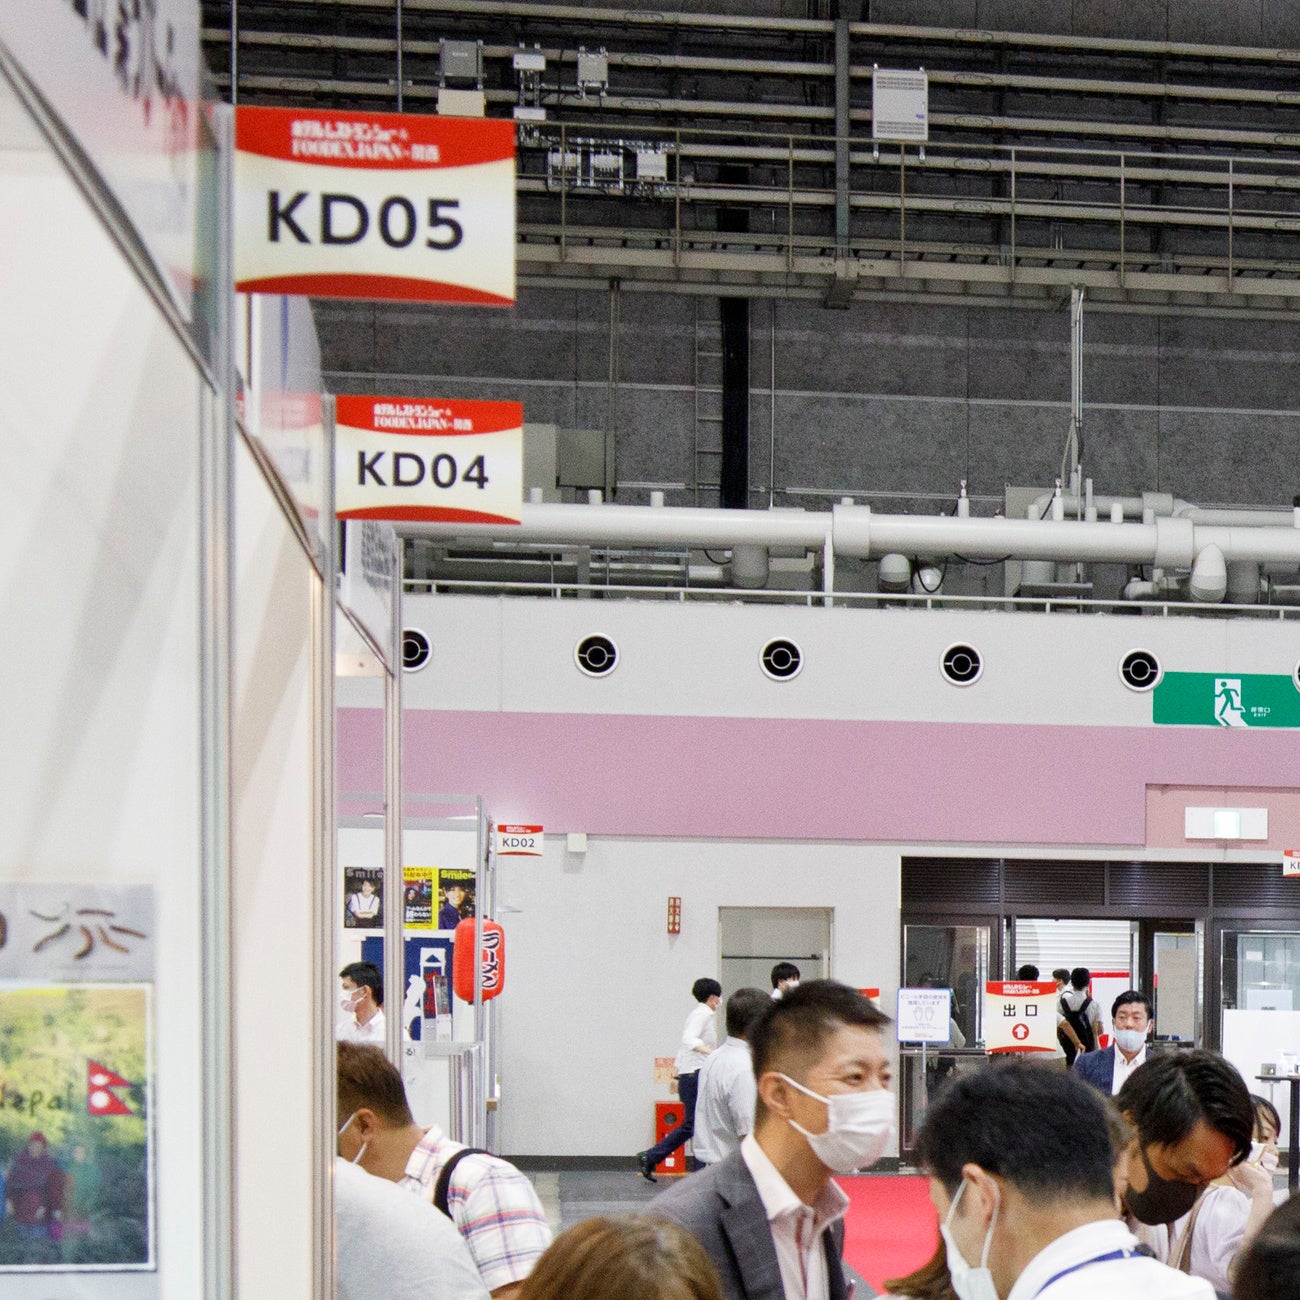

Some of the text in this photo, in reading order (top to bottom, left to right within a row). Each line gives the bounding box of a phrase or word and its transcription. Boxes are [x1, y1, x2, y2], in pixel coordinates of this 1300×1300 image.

[268, 190, 464, 250] KD05
[358, 451, 489, 489] KD04
[502, 837, 535, 849] KD02
[1003, 1003, 1038, 1017] 出口
